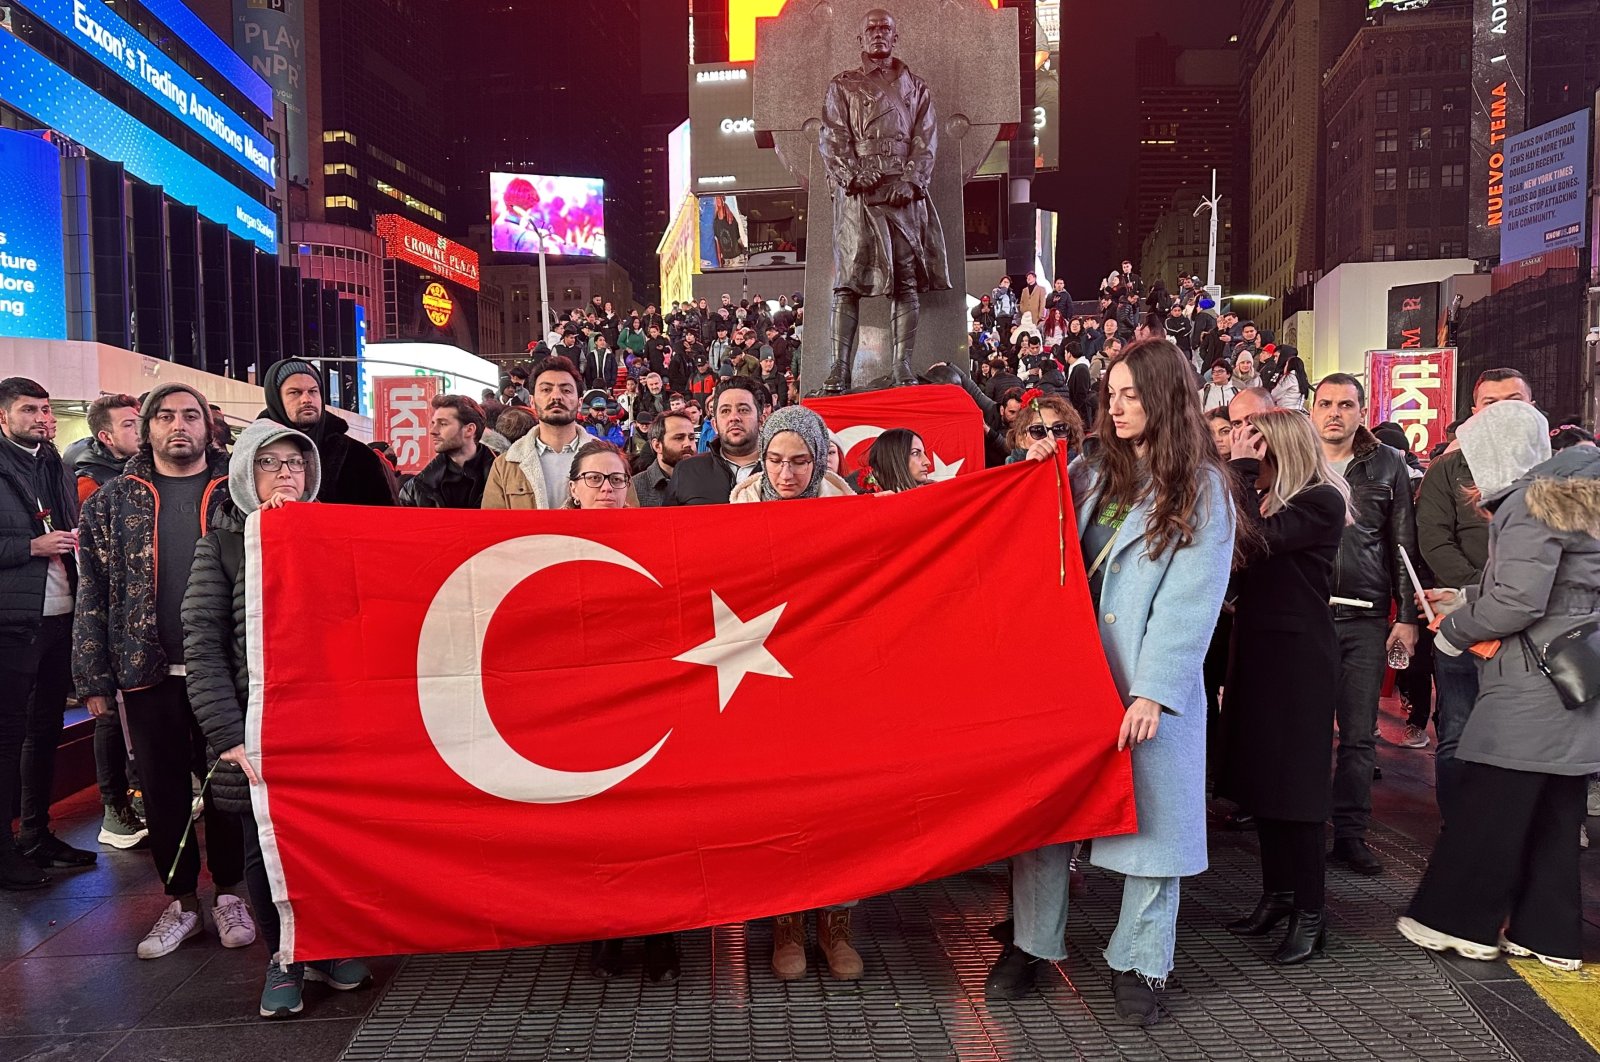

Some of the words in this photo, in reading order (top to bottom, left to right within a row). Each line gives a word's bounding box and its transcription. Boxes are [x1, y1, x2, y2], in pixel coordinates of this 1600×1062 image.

[74, 0, 136, 70] Exxon's
[136, 48, 188, 115] Trading
[190, 92, 243, 152] Ambitions
[244, 134, 269, 175] Mean
[696, 69, 748, 83] SAMSUNG
[1490, 82, 1507, 145] TEMA
[1510, 137, 1535, 153] ATTACKS
[1535, 134, 1543, 144] ON
[1544, 121, 1576, 140] ORTHODOX
[1510, 153, 1525, 166] JEWS
[1525, 148, 1540, 160] HAVE
[1541, 142, 1558, 154] MORE
[1558, 135, 1575, 148] THAN
[1508, 182, 1524, 194] DEAR
[1524, 177, 1537, 189] NEW
[1537, 172, 1553, 184] YORK
[1553, 165, 1575, 179] TIMES,
[1509, 162, 1535, 178] DOUBLED
[1535, 151, 1565, 169] RECENTLY.
[1487, 152, 1505, 227] NUEVO
[1508, 193, 1529, 206] WORDS
[1529, 190, 1537, 200] DO
[1537, 184, 1557, 197] BREAK
[1557, 177, 1580, 190] BONES.
[1508, 206, 1529, 219] PLEASE
[1529, 202, 1544, 213] STOP
[1544, 190, 1578, 207] ATTACKING
[236, 205, 255, 228] Morgan
[255, 218, 275, 242] Stanley
[1507, 221, 1519, 231] OUR
[1520, 209, 1557, 228] COMMUNITY.
[432, 263, 453, 277] HOTEL
[449, 255, 477, 277] PLAZA
[1391, 360, 1441, 453] tkts
[389, 383, 428, 466] tkts
